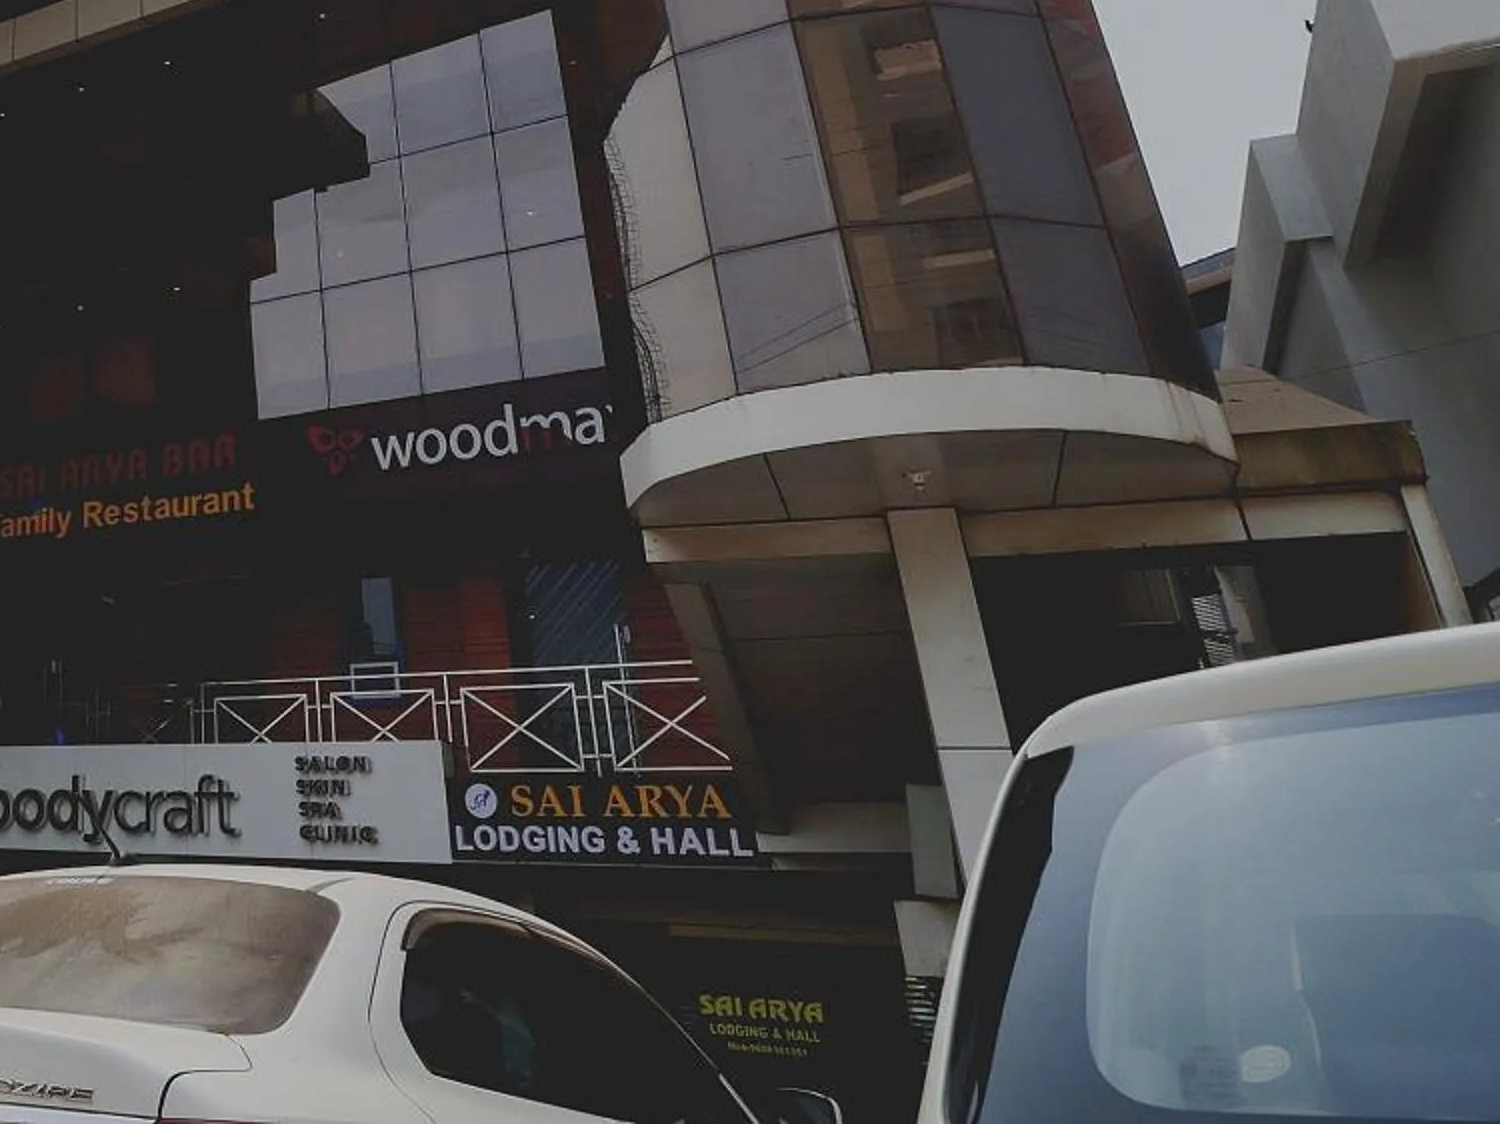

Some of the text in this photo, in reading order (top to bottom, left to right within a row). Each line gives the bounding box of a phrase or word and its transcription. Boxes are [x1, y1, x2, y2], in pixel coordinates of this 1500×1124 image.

[370, 402, 614, 472] woodma
[60, 447, 149, 492] ARYA
[160, 430, 239, 477] BAR
[83, 479, 257, 529] Restaurant
[295, 755, 372, 774] SALON
[510, 783, 587, 818] SAI
[602, 783, 733, 819] ARYA
[300, 825, 379, 844] CLINIC
[455, 825, 754, 857] LODGING & HALL
[699, 993, 825, 1024] SAI ARYA
[708, 1020, 770, 1039] LODGING
[786, 1027, 821, 1044] HALL
